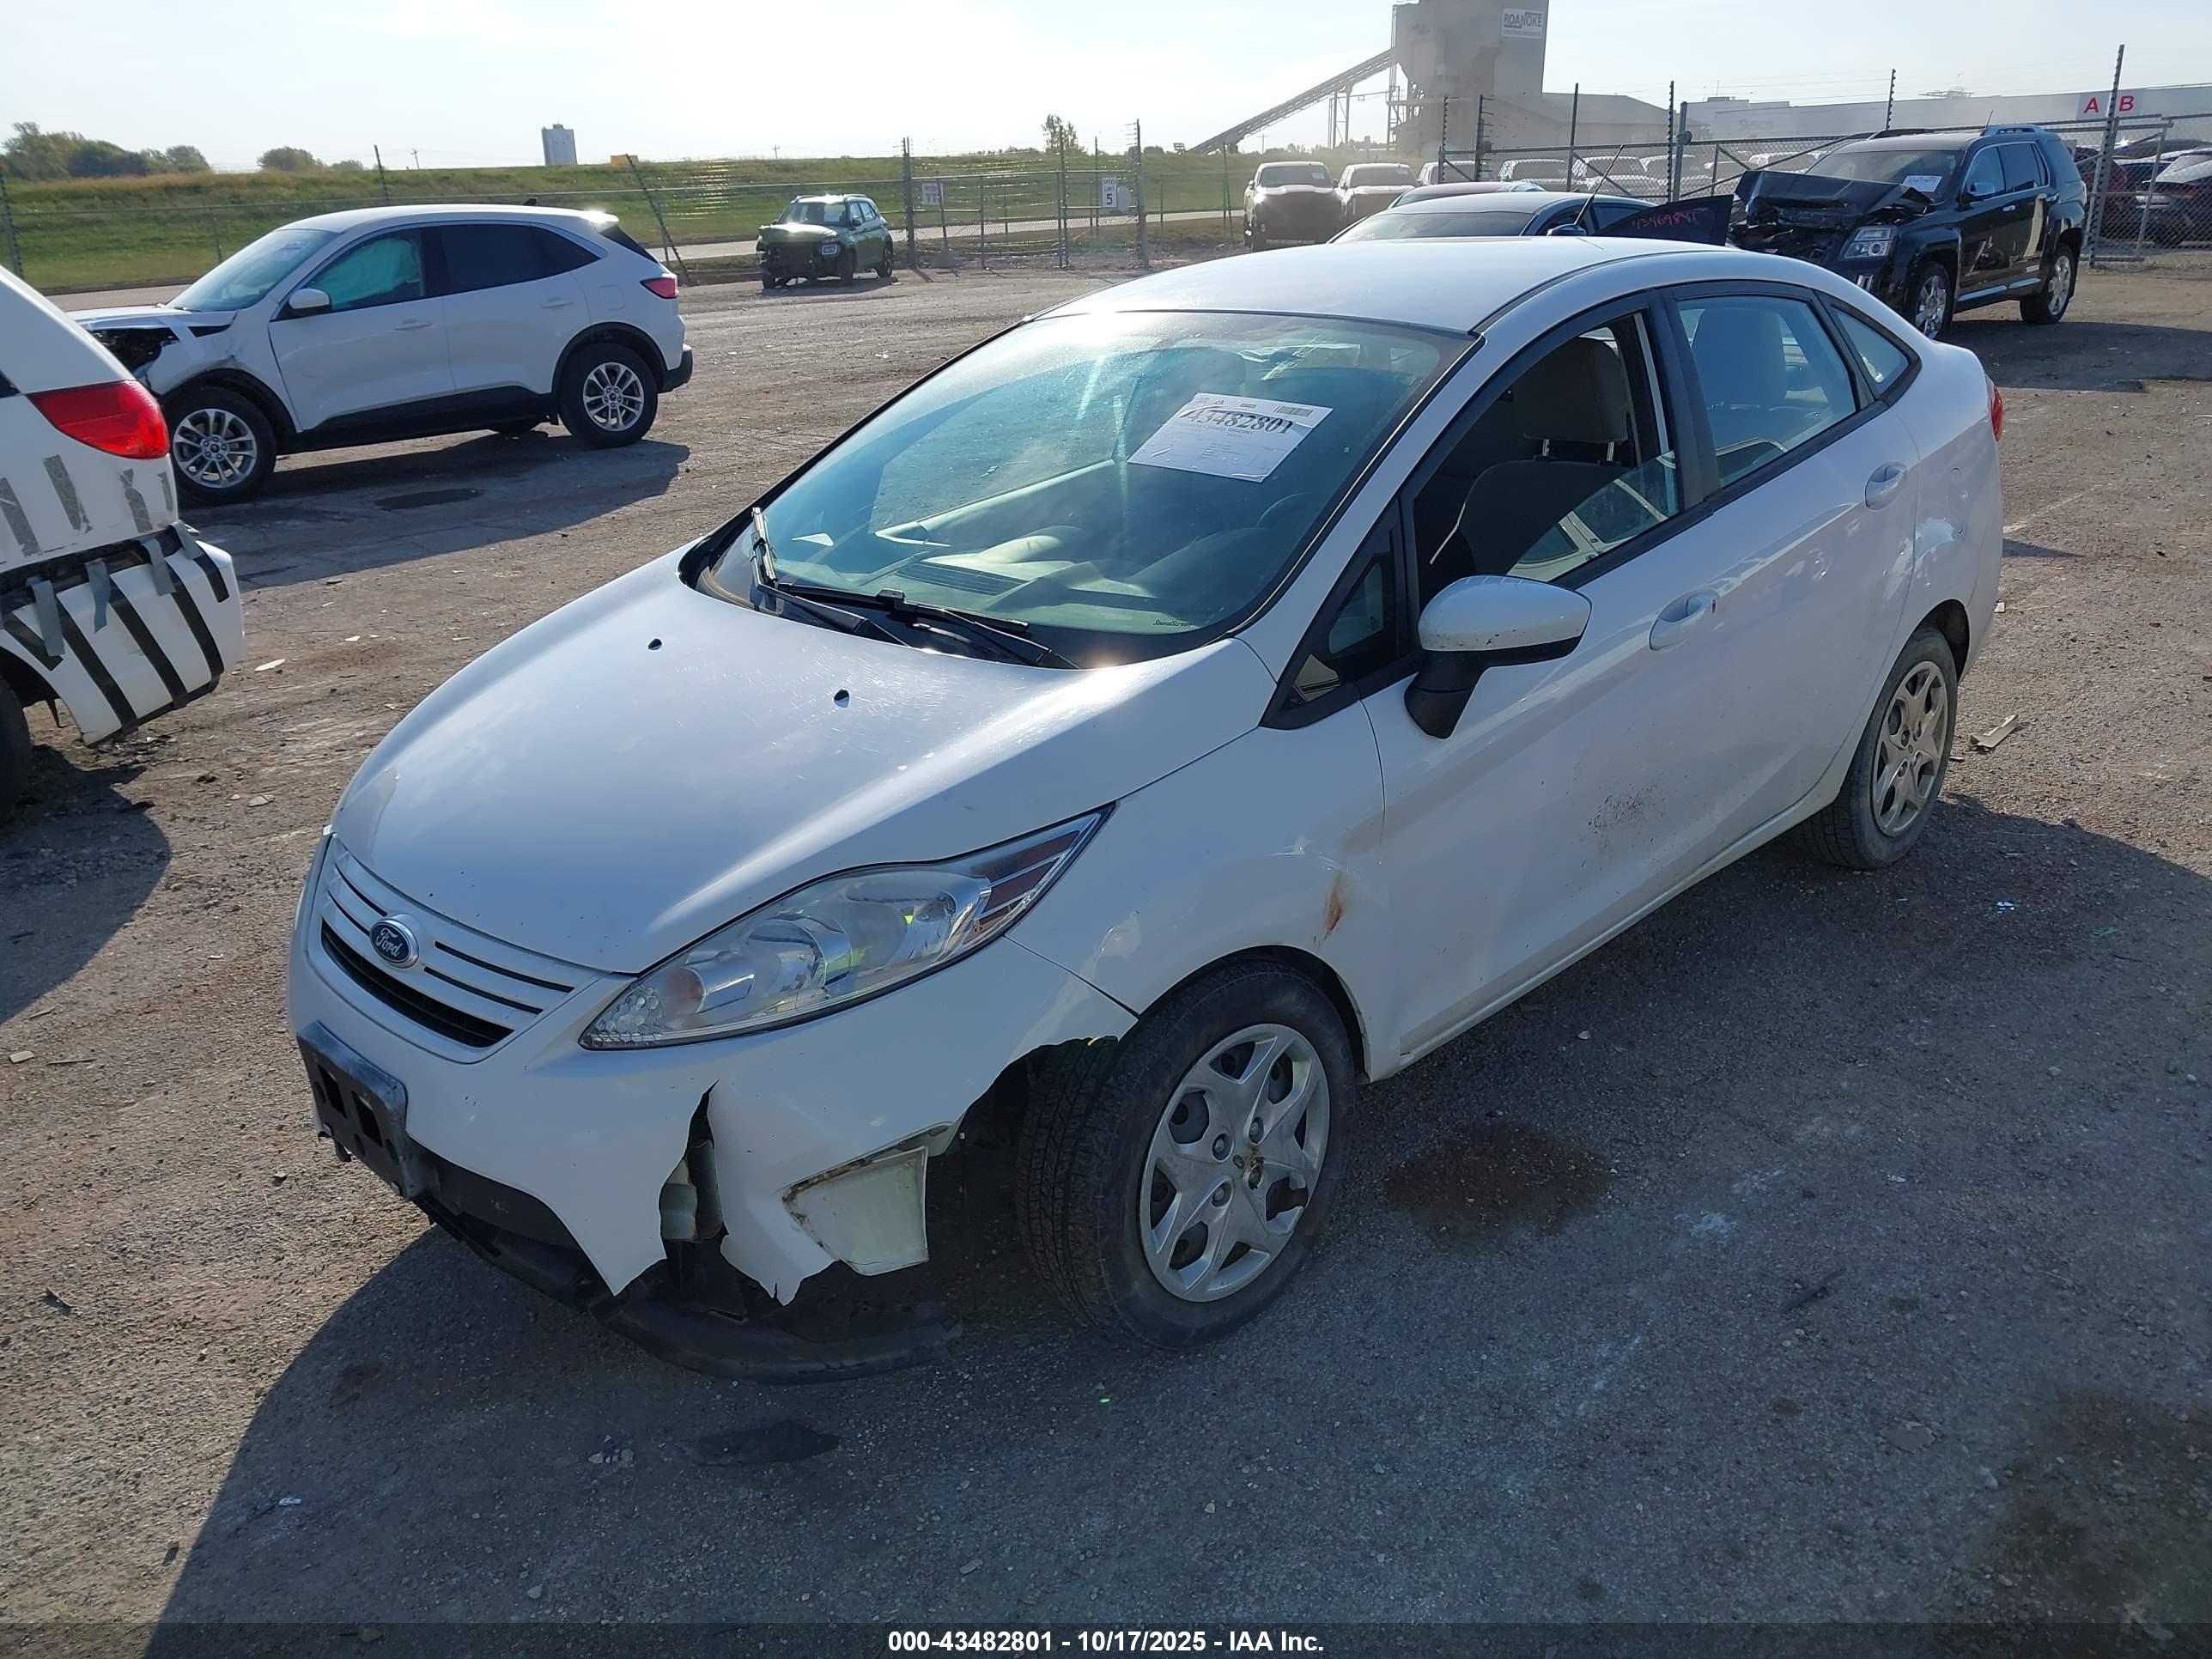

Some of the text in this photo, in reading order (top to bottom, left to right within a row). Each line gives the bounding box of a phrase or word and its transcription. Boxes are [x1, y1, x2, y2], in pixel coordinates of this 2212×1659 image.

[1504, 13, 1542, 27] ROANOKE
[2084, 96, 2134, 113] A B
[1106, 193, 1113, 205] 5
[1188, 410, 1293, 434] 43482801
[375, 927, 404, 957] Ford
